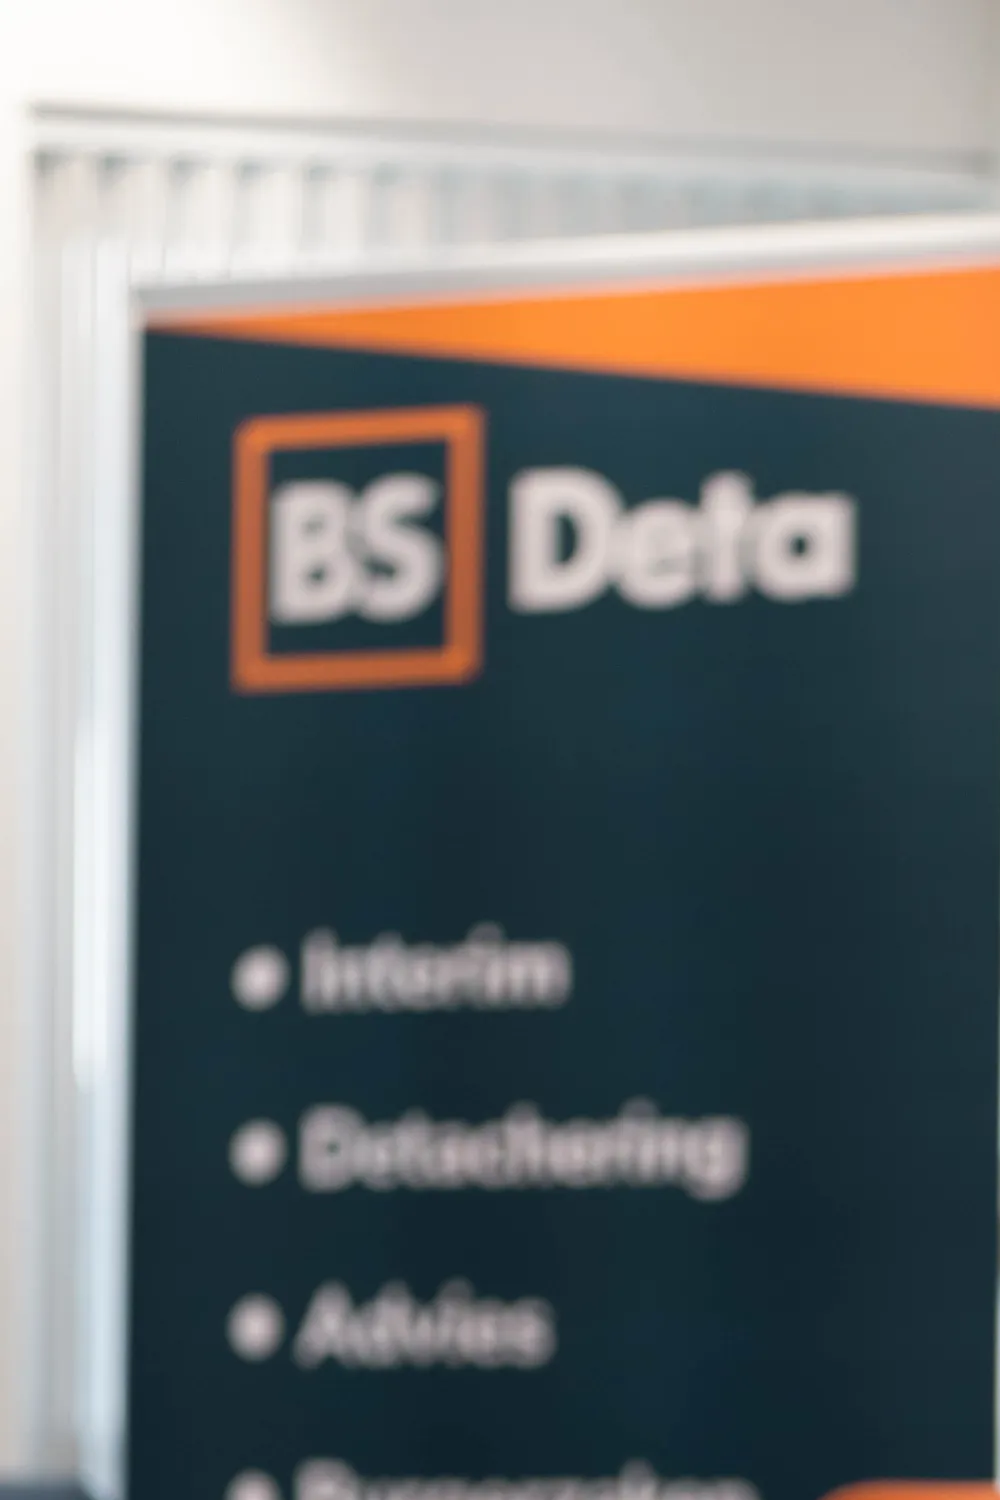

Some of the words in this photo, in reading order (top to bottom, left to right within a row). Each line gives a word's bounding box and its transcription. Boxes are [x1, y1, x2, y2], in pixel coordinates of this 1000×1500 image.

[272, 474, 442, 622] BS
[510, 467, 855, 610] Deta
[301, 925, 571, 1010] Interim
[299, 1101, 746, 1199] Detachering
[296, 1282, 552, 1366] Advies
